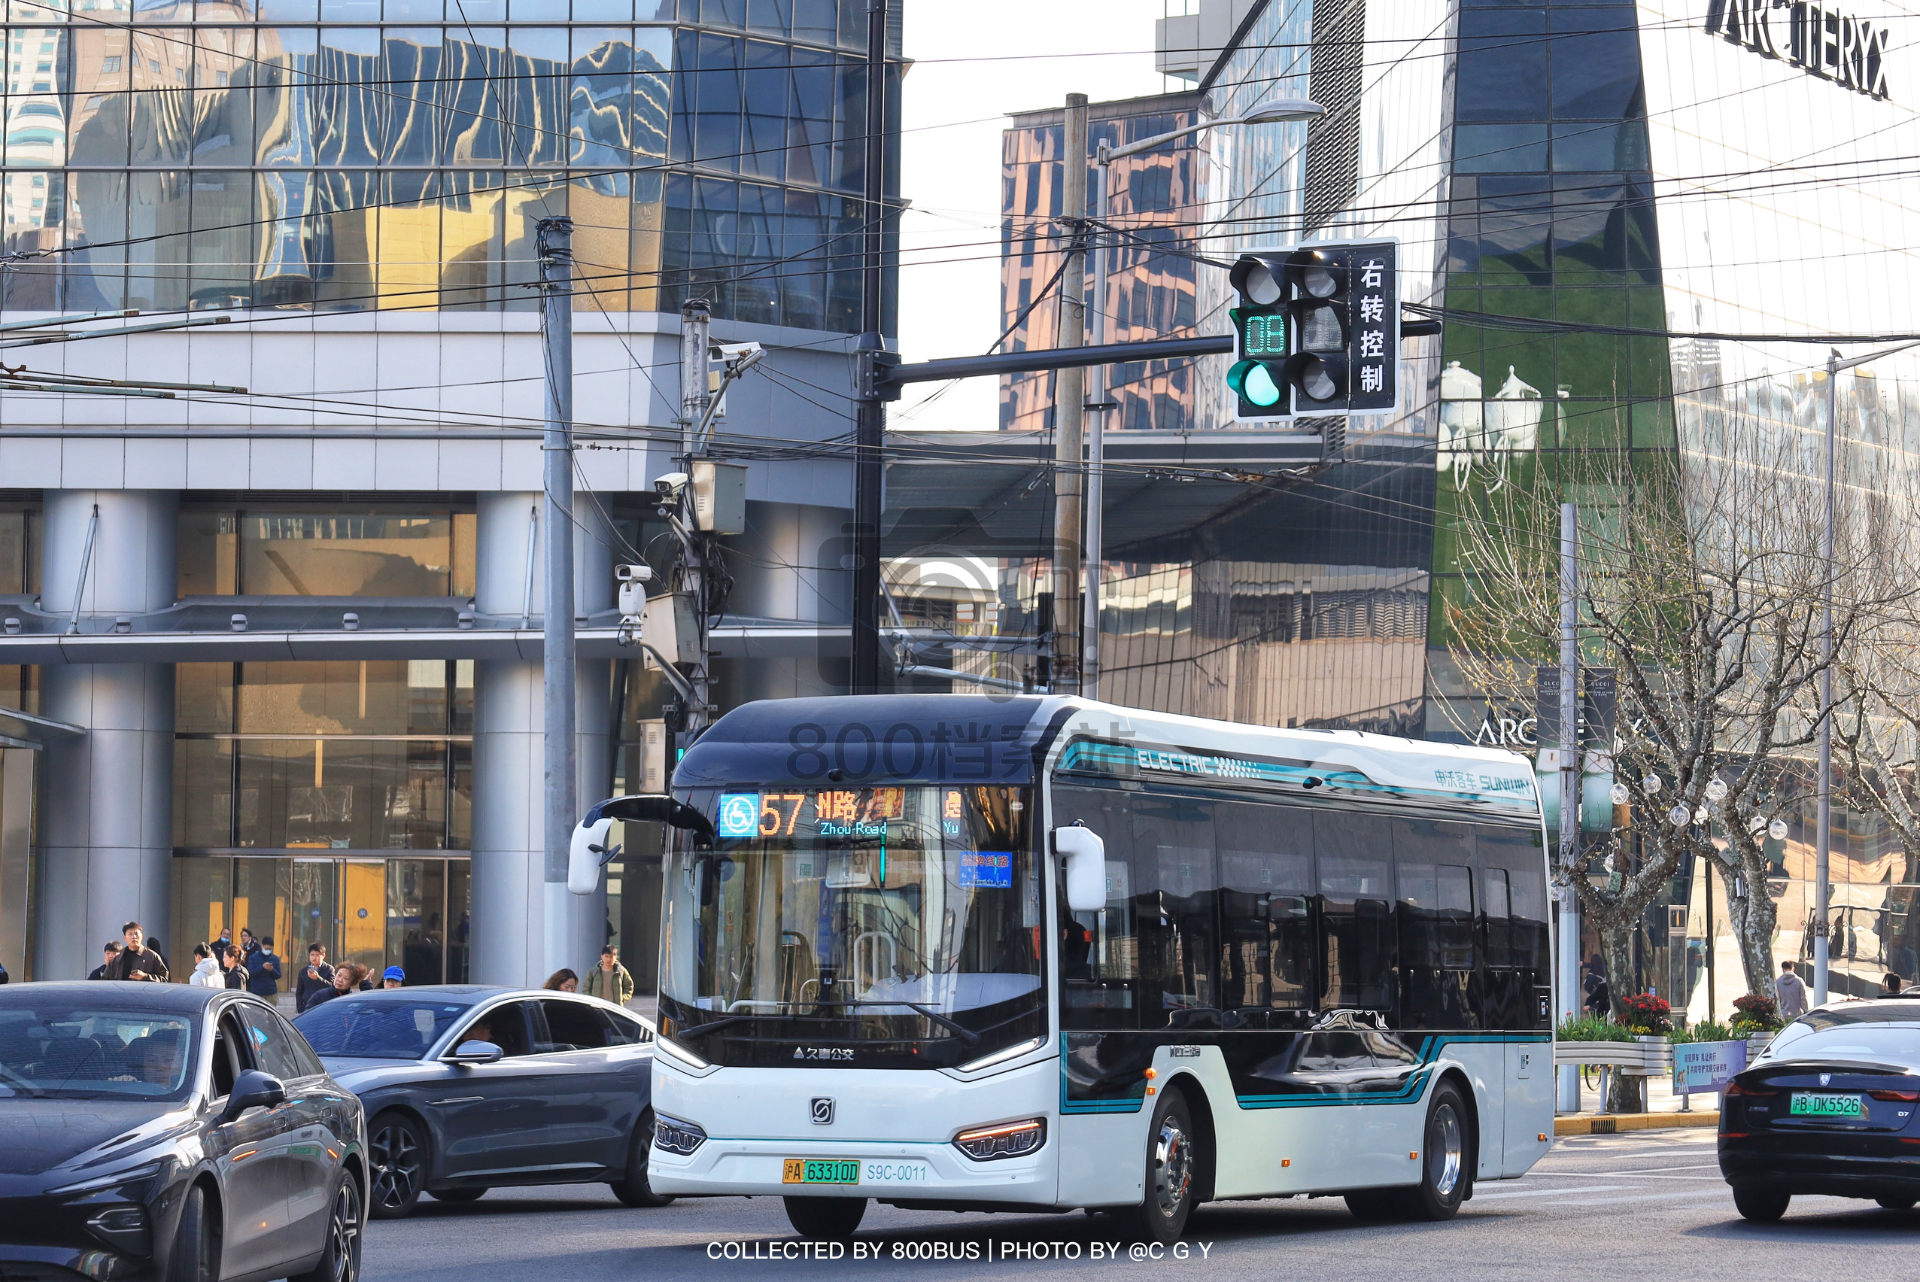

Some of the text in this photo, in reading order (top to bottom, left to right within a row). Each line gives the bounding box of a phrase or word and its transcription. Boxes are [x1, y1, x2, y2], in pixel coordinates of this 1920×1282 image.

[1246, 314, 1285, 353] 08
[1360, 259, 1385, 393] 右转控制
[1137, 749, 1214, 775] ELECTRIC
[1434, 769, 1477, 790] 申沃客车
[1479, 774, 1531, 795] SUNWIN
[759, 794, 806, 836] 57
[820, 821, 887, 835] Zhou Road
[867, 1164, 926, 1181] S9C-0011
